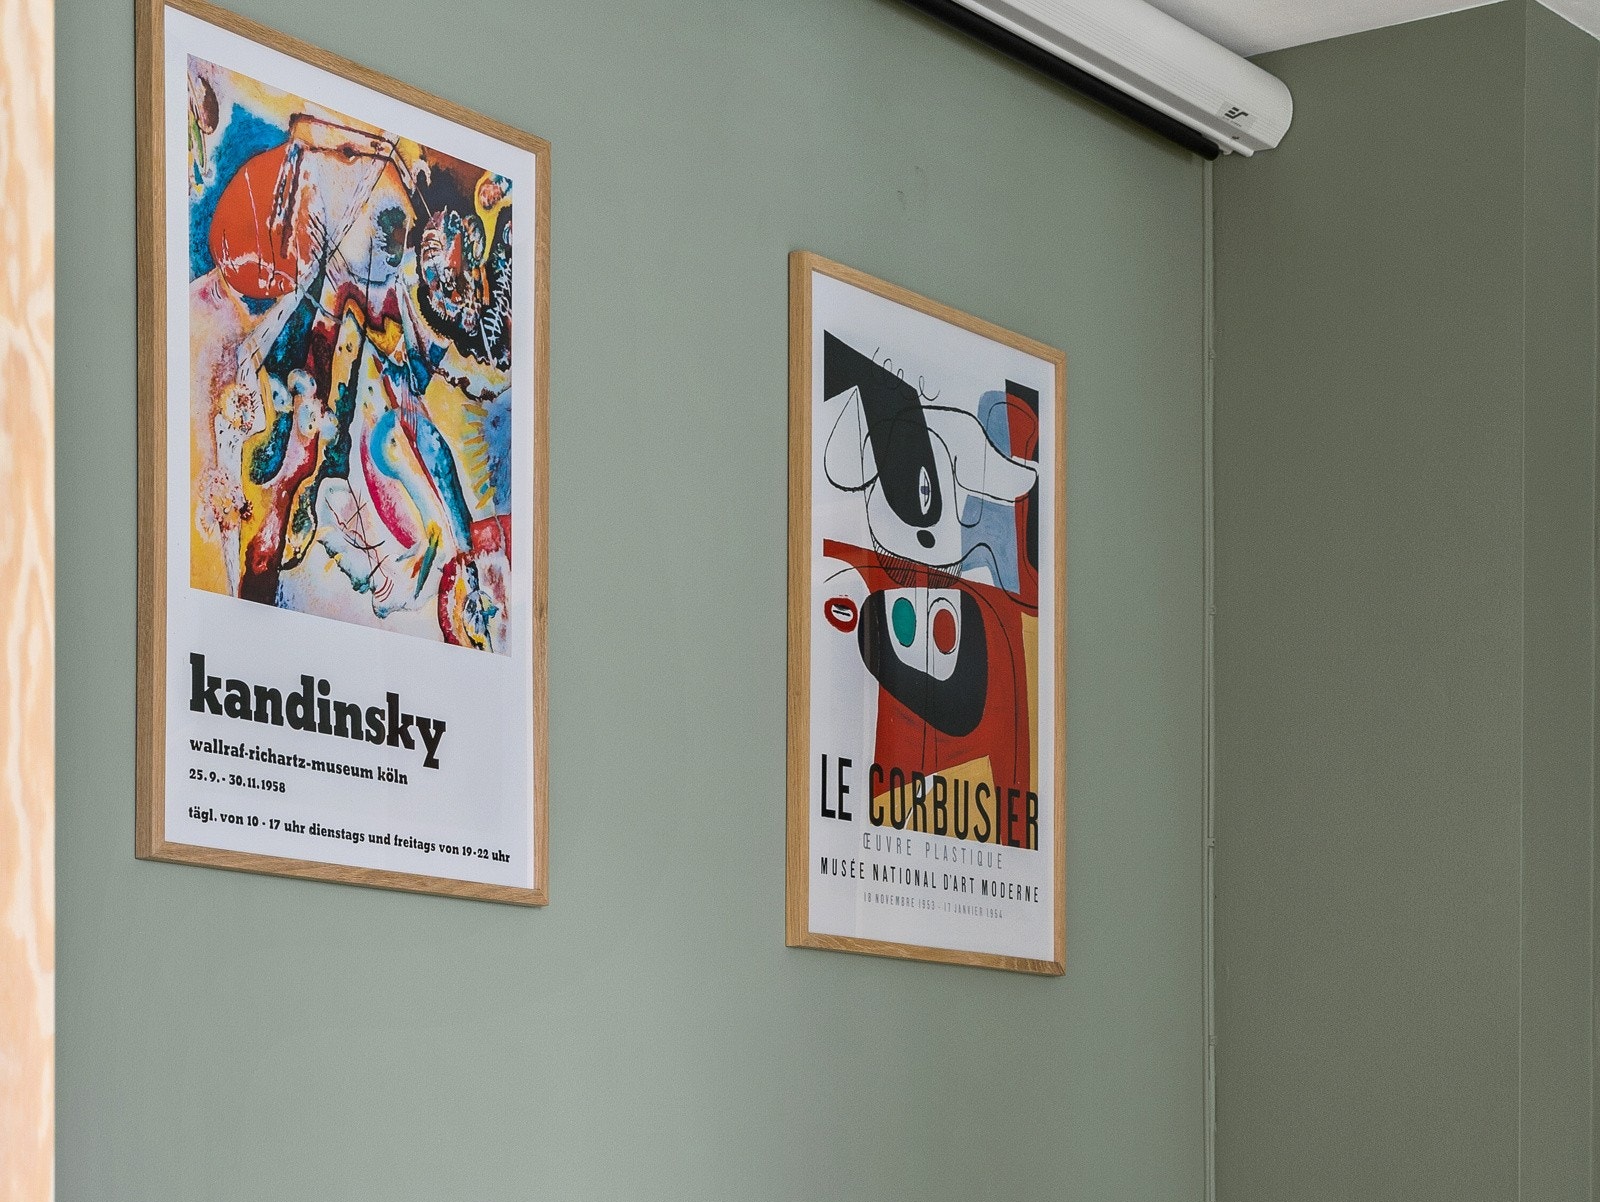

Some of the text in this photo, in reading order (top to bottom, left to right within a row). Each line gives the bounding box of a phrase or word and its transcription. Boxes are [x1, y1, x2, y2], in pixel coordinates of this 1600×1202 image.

[190, 652, 446, 769] kandinsky
[190, 737, 408, 785] wallraf-richartz-museum köln
[821, 754, 1040, 851] LE CORBUSIER
[188, 807, 511, 863] tägl. von 10 17 uhr dienstags und freitags von 19-22 uhr
[862, 833, 1003, 870] ŒUVRE PLASTIQUE
[821, 857, 1040, 904] MUSÉE NATIONAL D'ART MODERNE
[875, 893, 916, 909] NOVEMBRE
[918, 897, 936, 911] 1953
[954, 903, 984, 917] JANVIER
